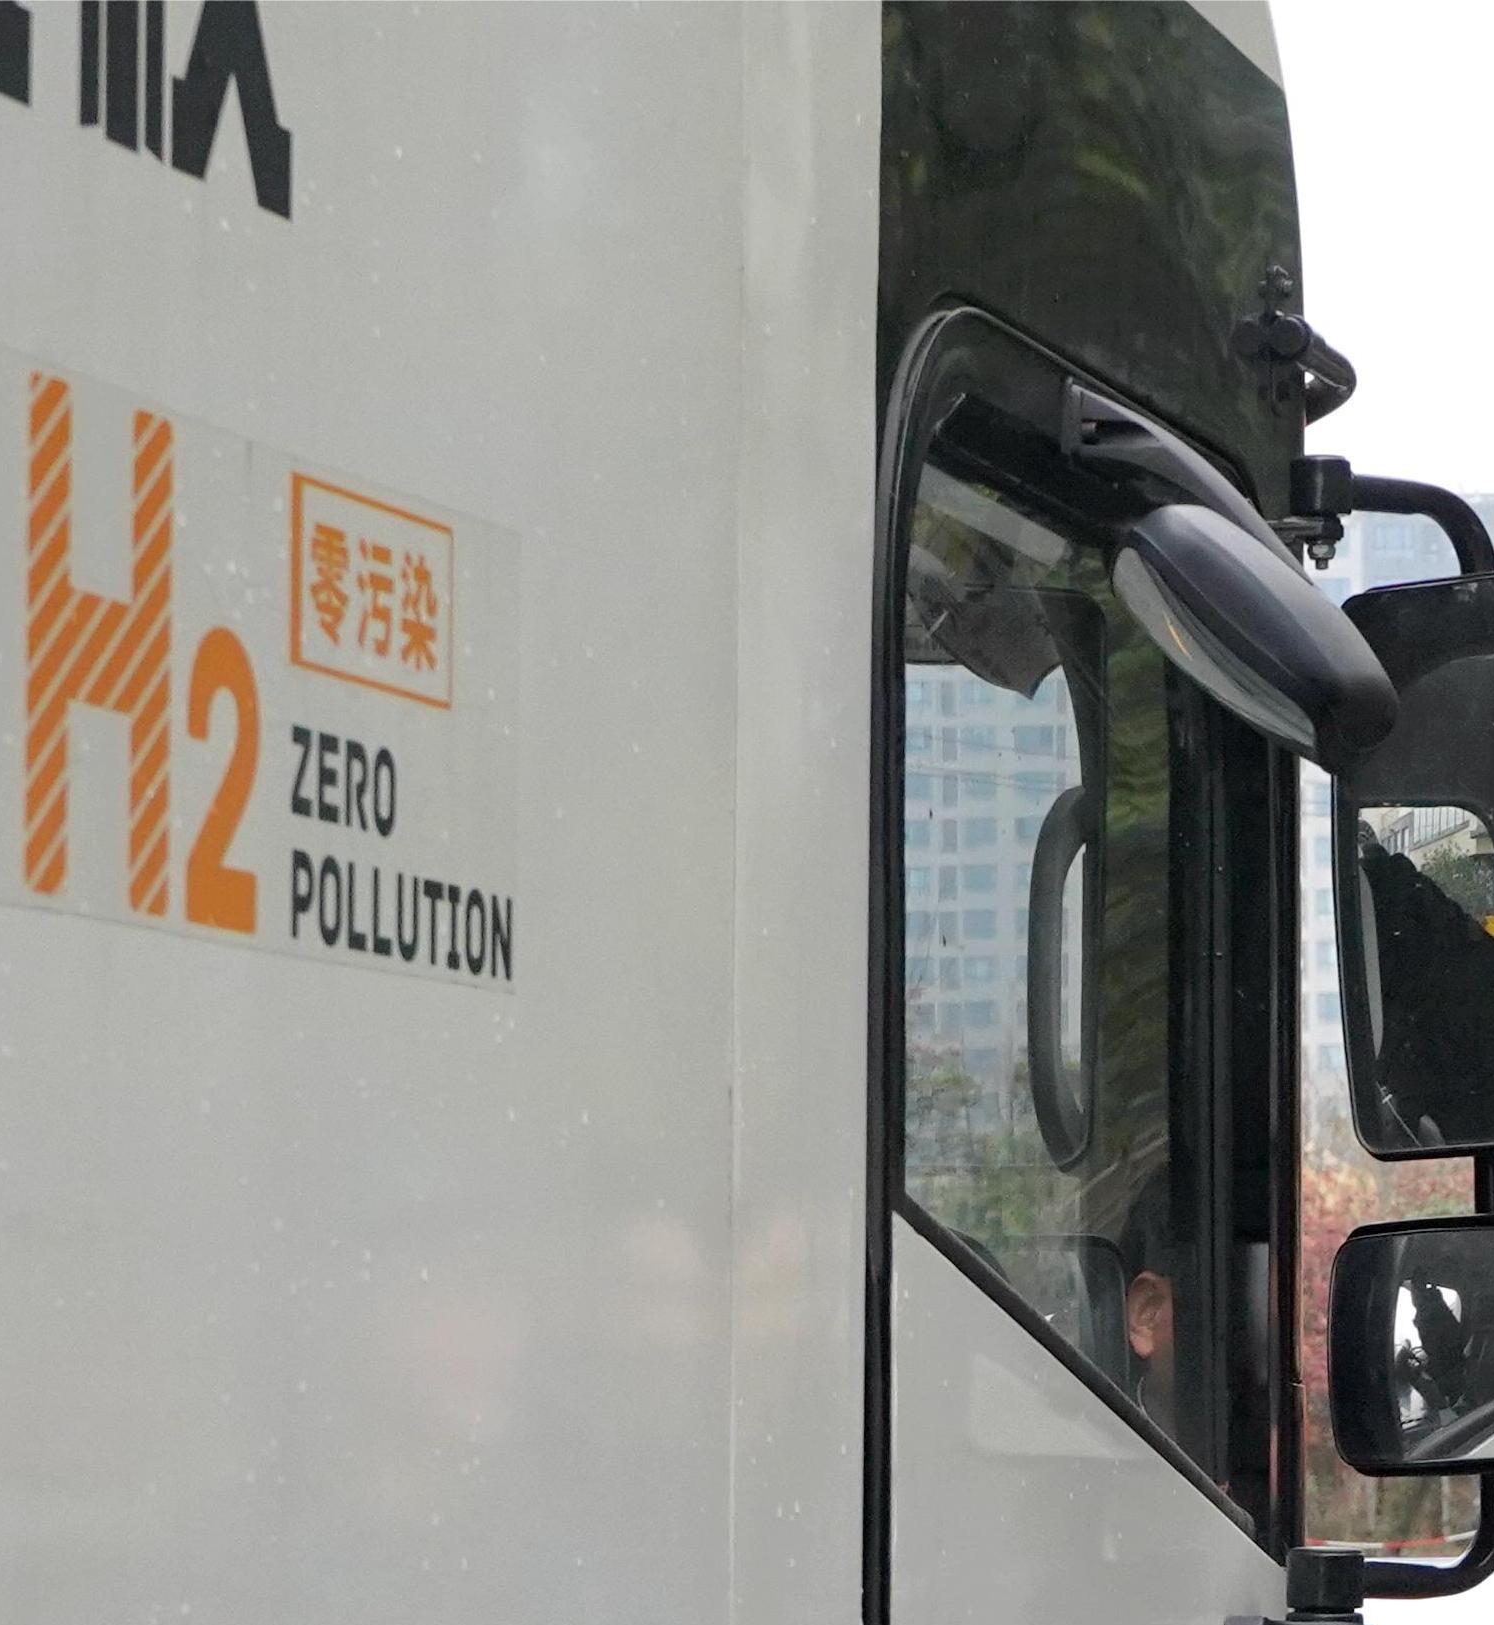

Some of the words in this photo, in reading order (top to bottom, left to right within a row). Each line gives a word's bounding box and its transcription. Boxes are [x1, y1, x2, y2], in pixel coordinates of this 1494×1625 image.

[24, 370, 261, 936] H2
[308, 521, 440, 671] 零污染
[291, 723, 398, 838] ZERO
[291, 848, 514, 982] POLLUTION
